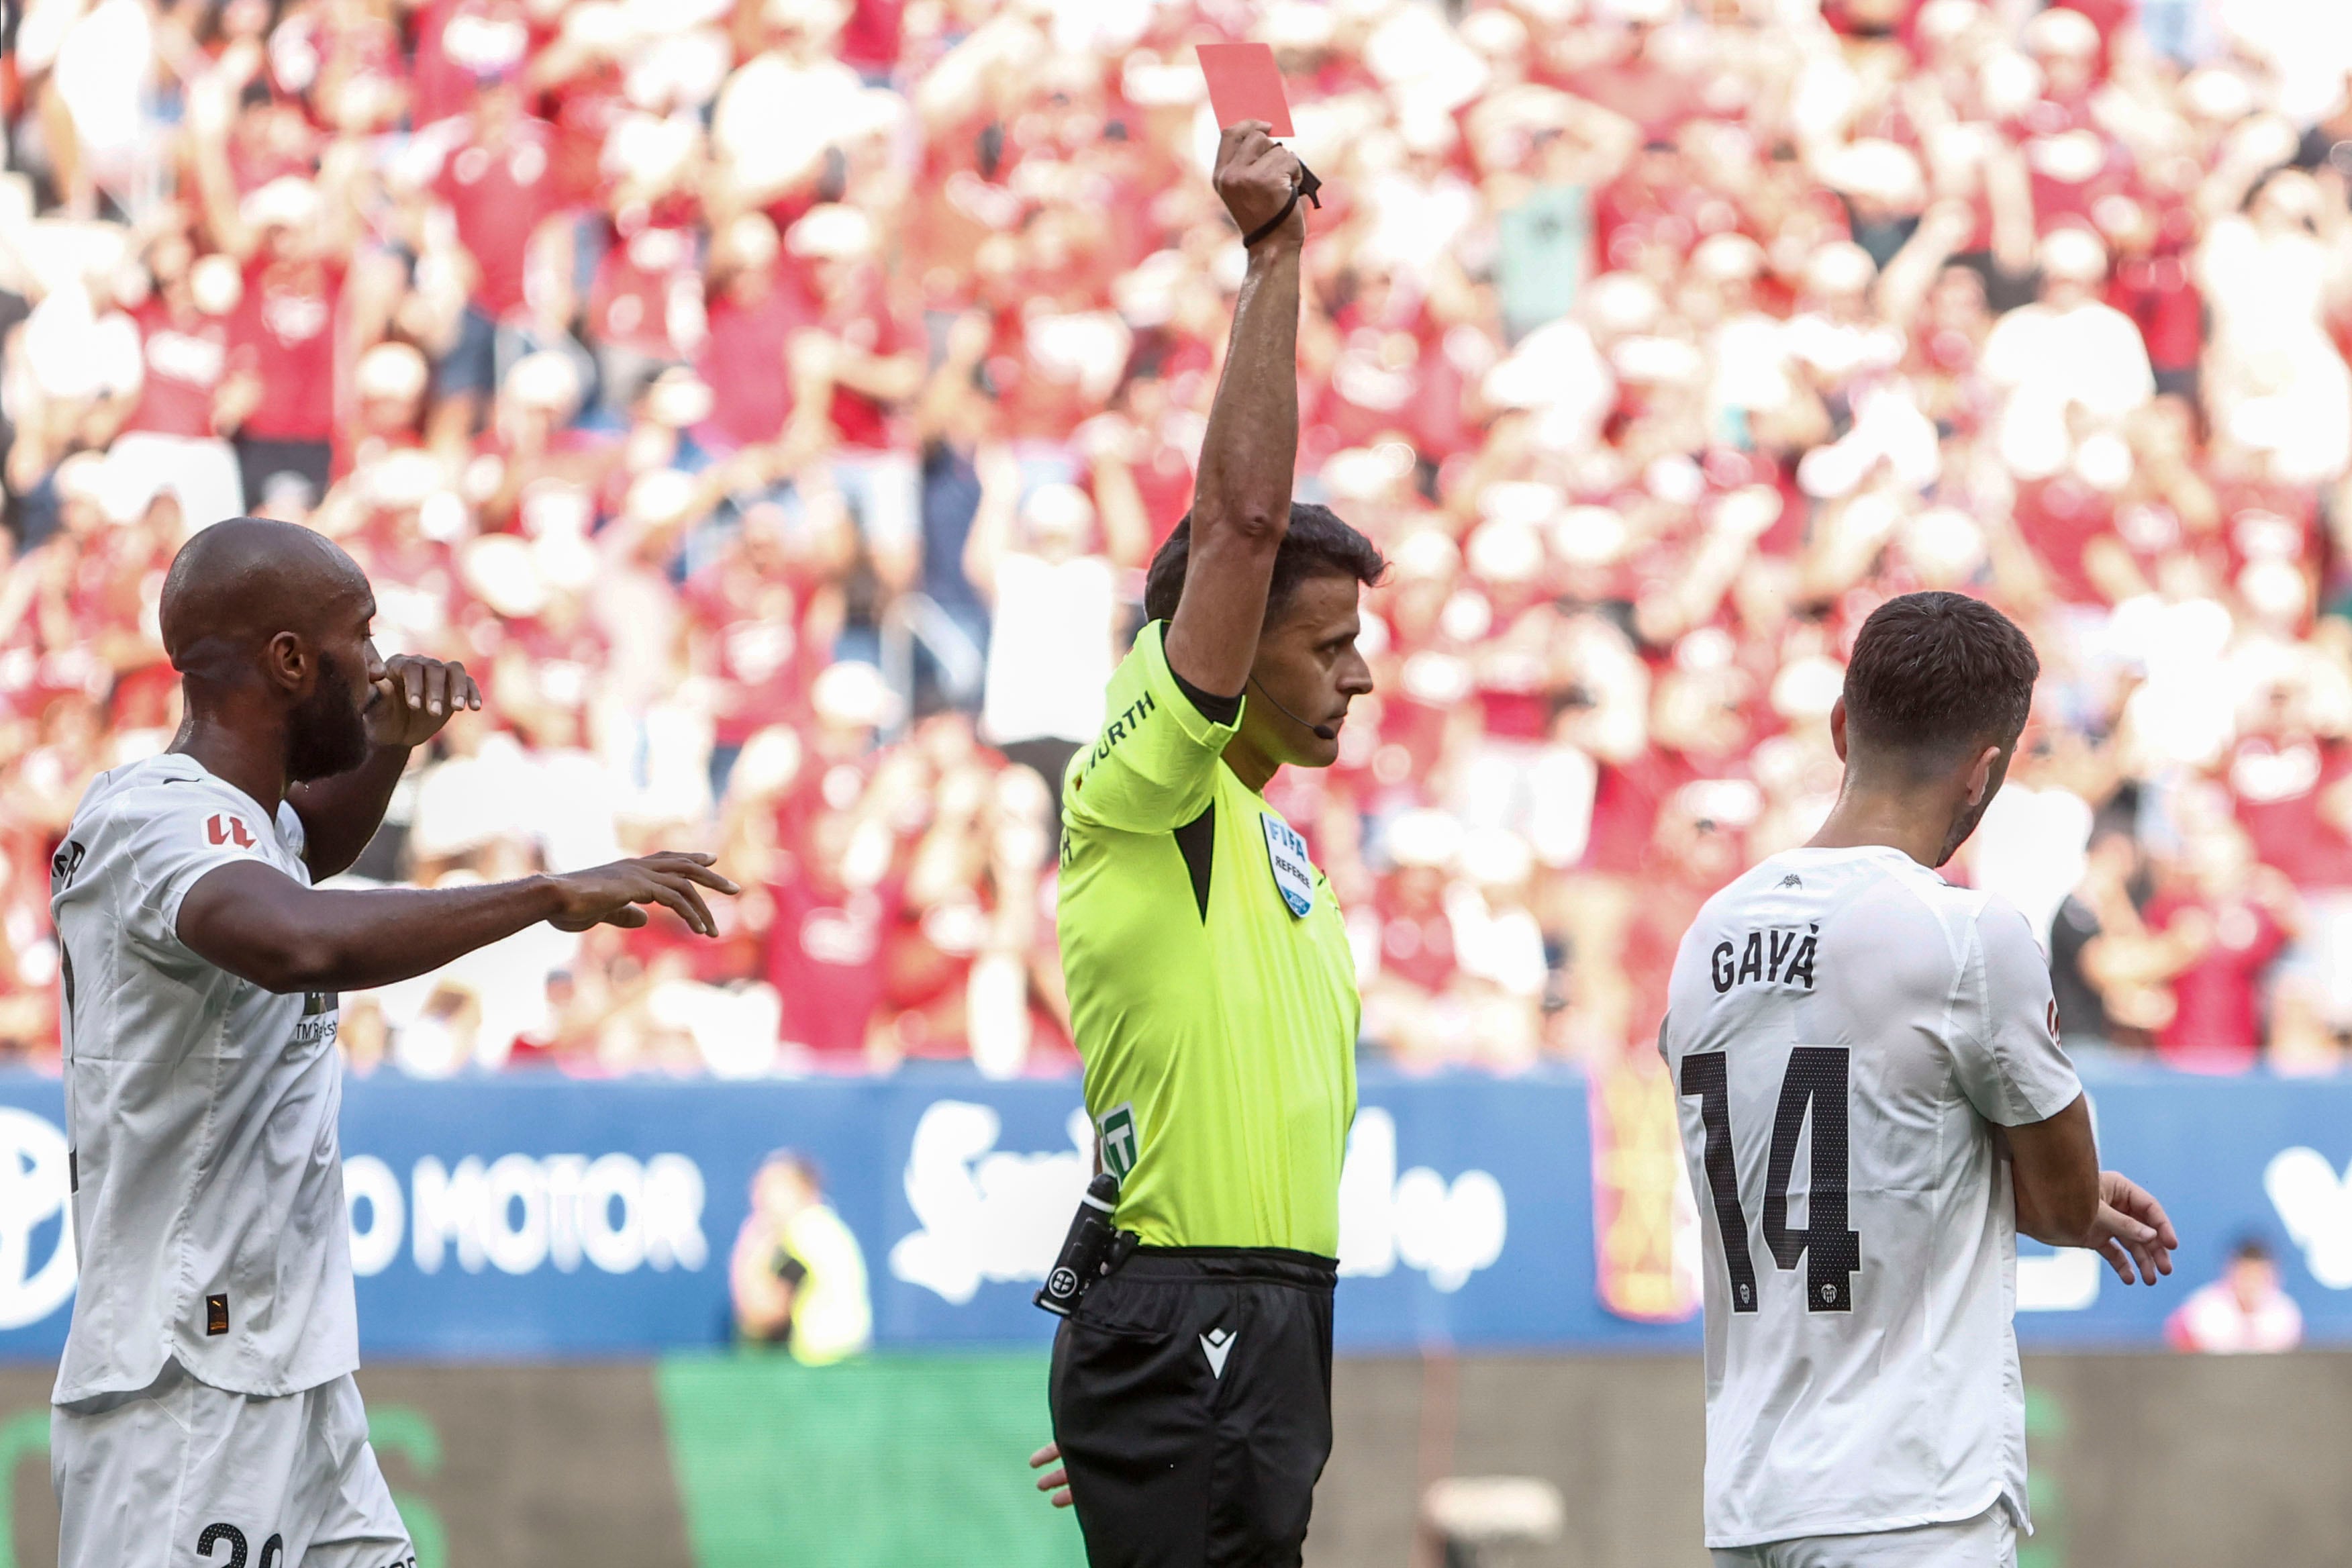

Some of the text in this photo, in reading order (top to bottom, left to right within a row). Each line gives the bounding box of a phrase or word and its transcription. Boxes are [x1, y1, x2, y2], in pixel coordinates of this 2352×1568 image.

[1268, 819, 1306, 863] FIFA
[1275, 855, 1311, 889] REFEREE
[411, 1152, 709, 1275] MOTOR
[1681, 1046, 1860, 1312] 14
